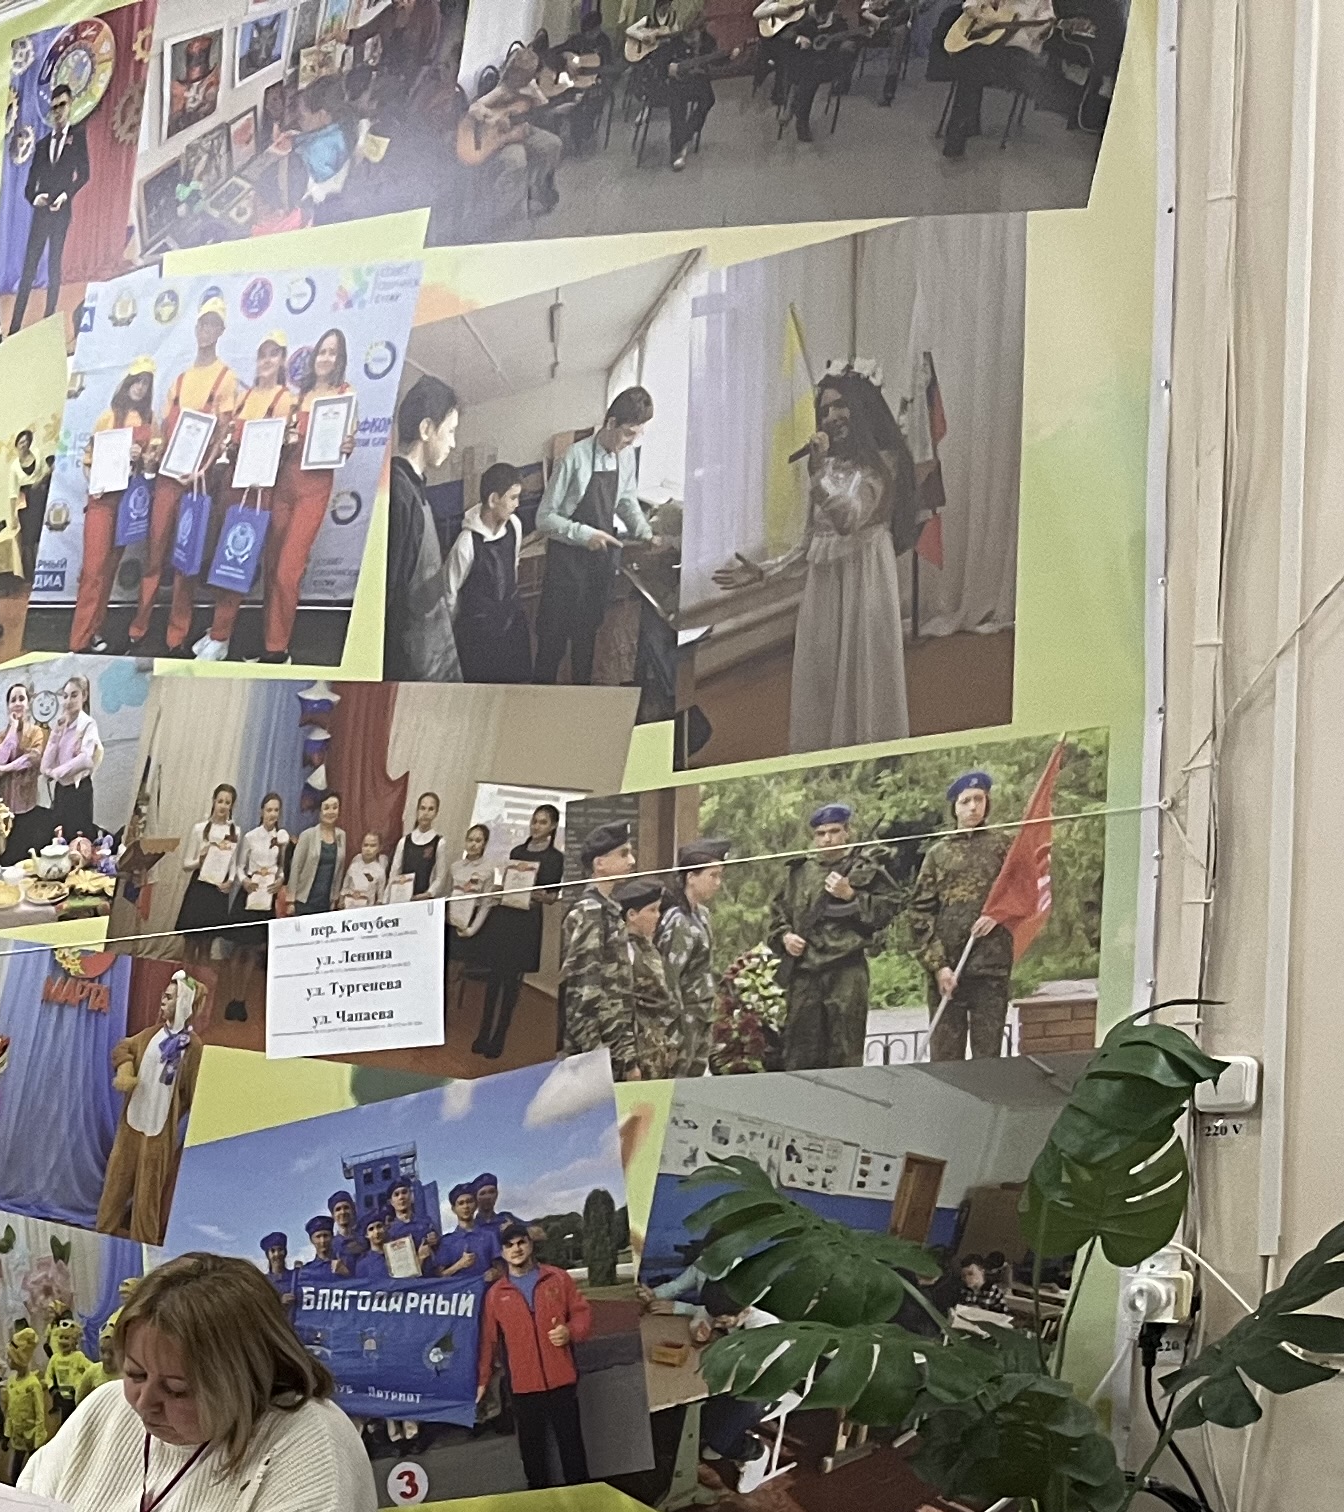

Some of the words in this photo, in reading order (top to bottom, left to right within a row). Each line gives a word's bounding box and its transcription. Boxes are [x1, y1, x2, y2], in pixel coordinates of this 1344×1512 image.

[341, 916, 401, 934] Кочубея
[315, 955, 335, 970] ул.
[338, 949, 393, 964] Ленина
[306, 987, 325, 1001] ул.
[328, 979, 402, 998] Тургенева
[312, 1015, 332, 1029] ул.
[336, 1009, 394, 1023] Чапаева
[1232, 1123, 1243, 1135] V
[301, 1286, 475, 1318] БЛАГОДАРНЫЙ
[396, 1470, 419, 1500] 3
